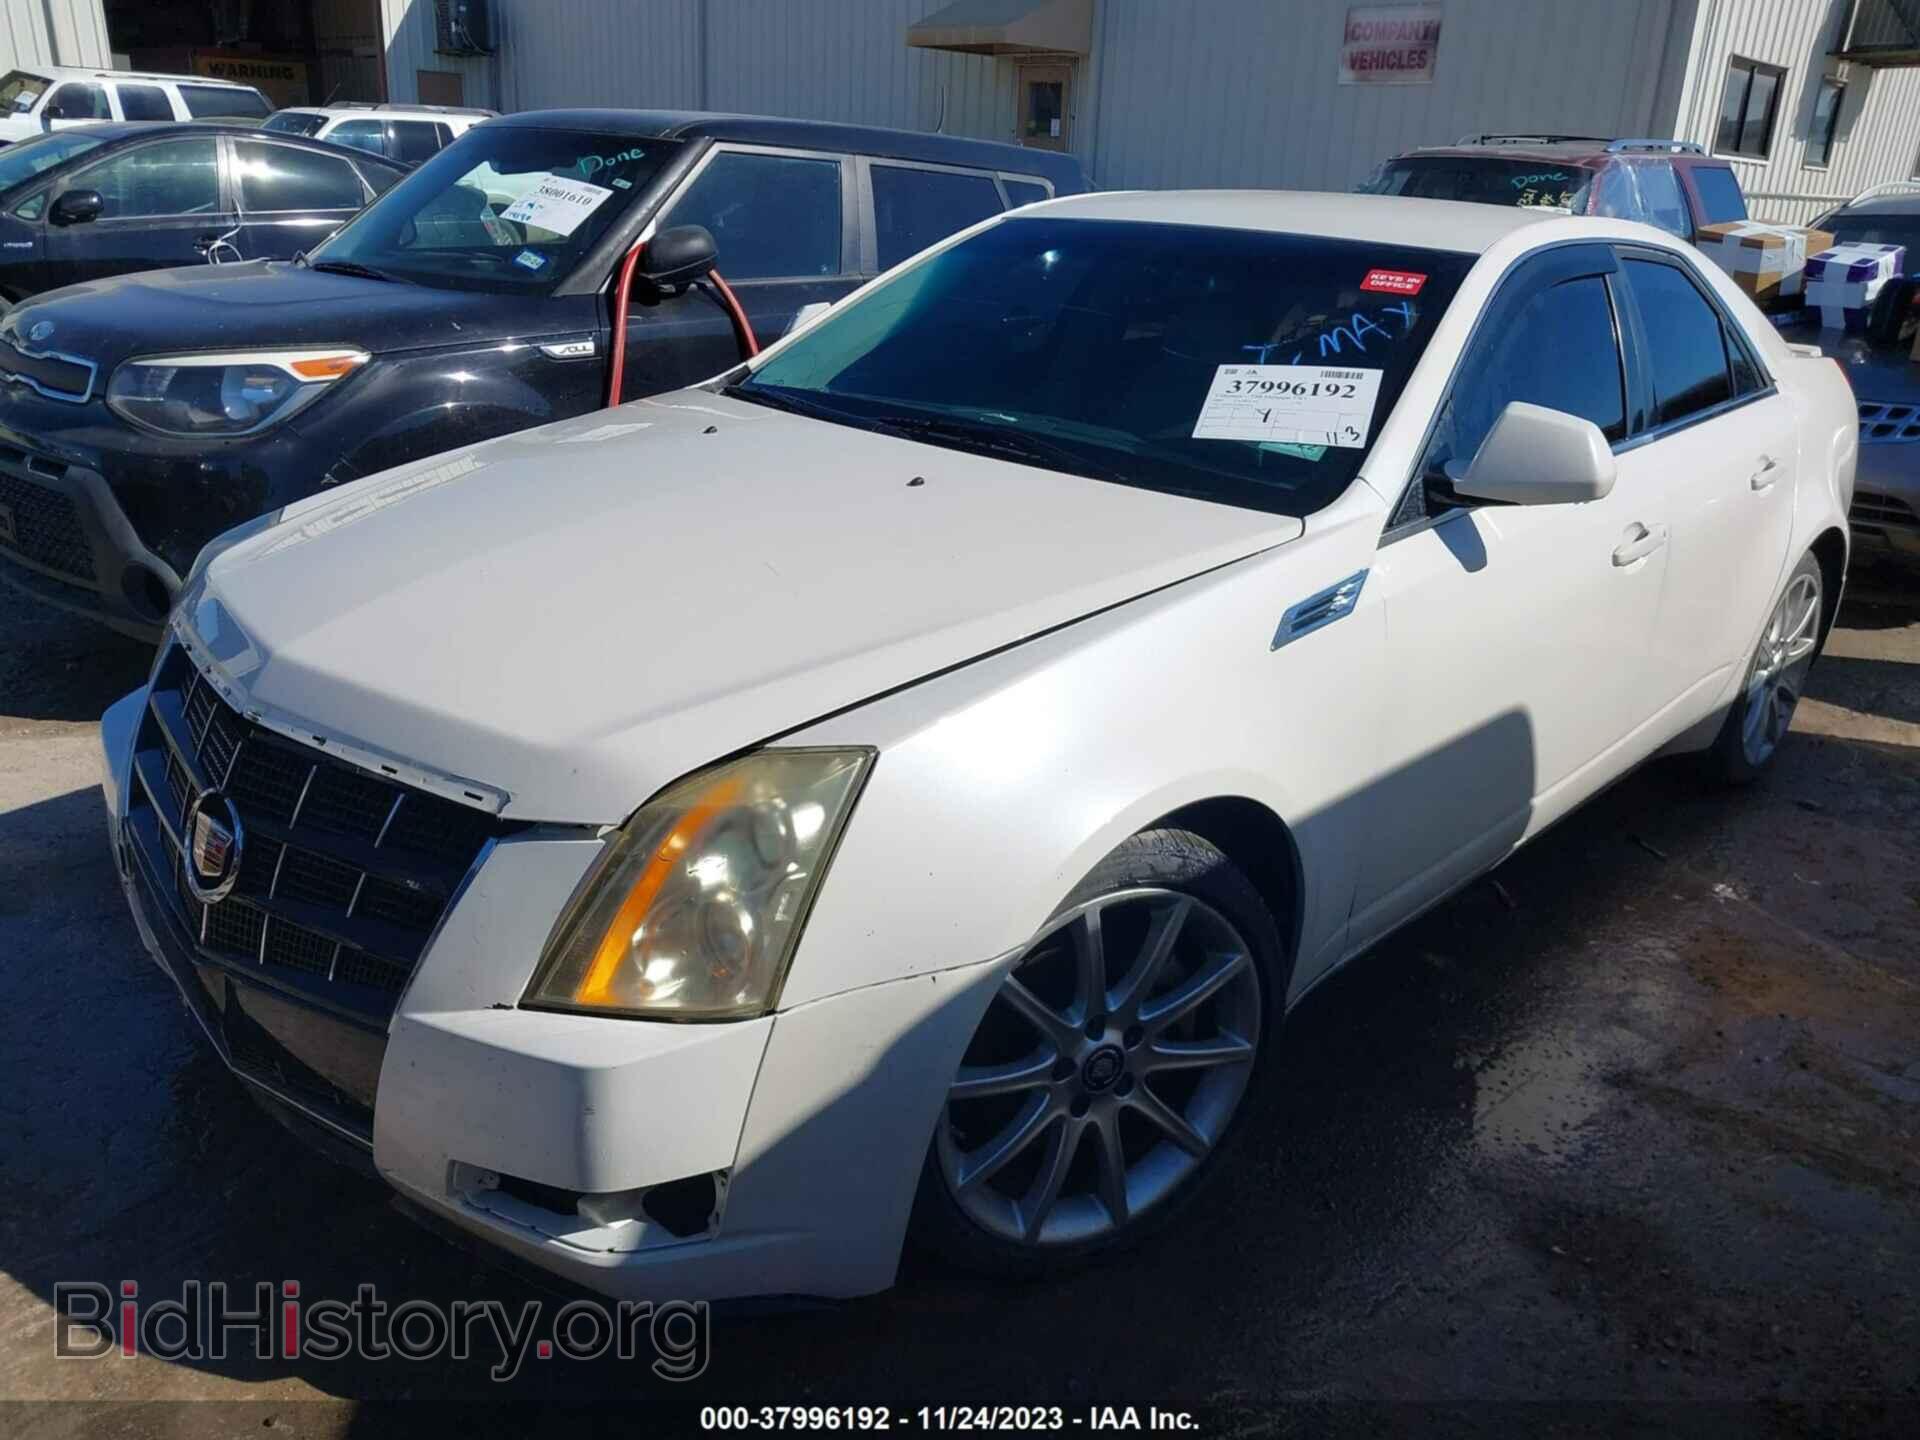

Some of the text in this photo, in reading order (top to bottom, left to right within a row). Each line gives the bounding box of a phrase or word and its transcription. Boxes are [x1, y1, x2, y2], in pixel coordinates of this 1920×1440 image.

[1350, 20, 1433, 41] COMPANY
[1350, 50, 1427, 70] VEHICLES
[207, 63, 295, 80] WARNING
[577, 148, 645, 174] Done
[1511, 172, 1568, 188] Done
[1370, 273, 1404, 282] KEYS
[1370, 280, 1414, 289] OFFICE
[1225, 380, 1356, 399] 37996192
